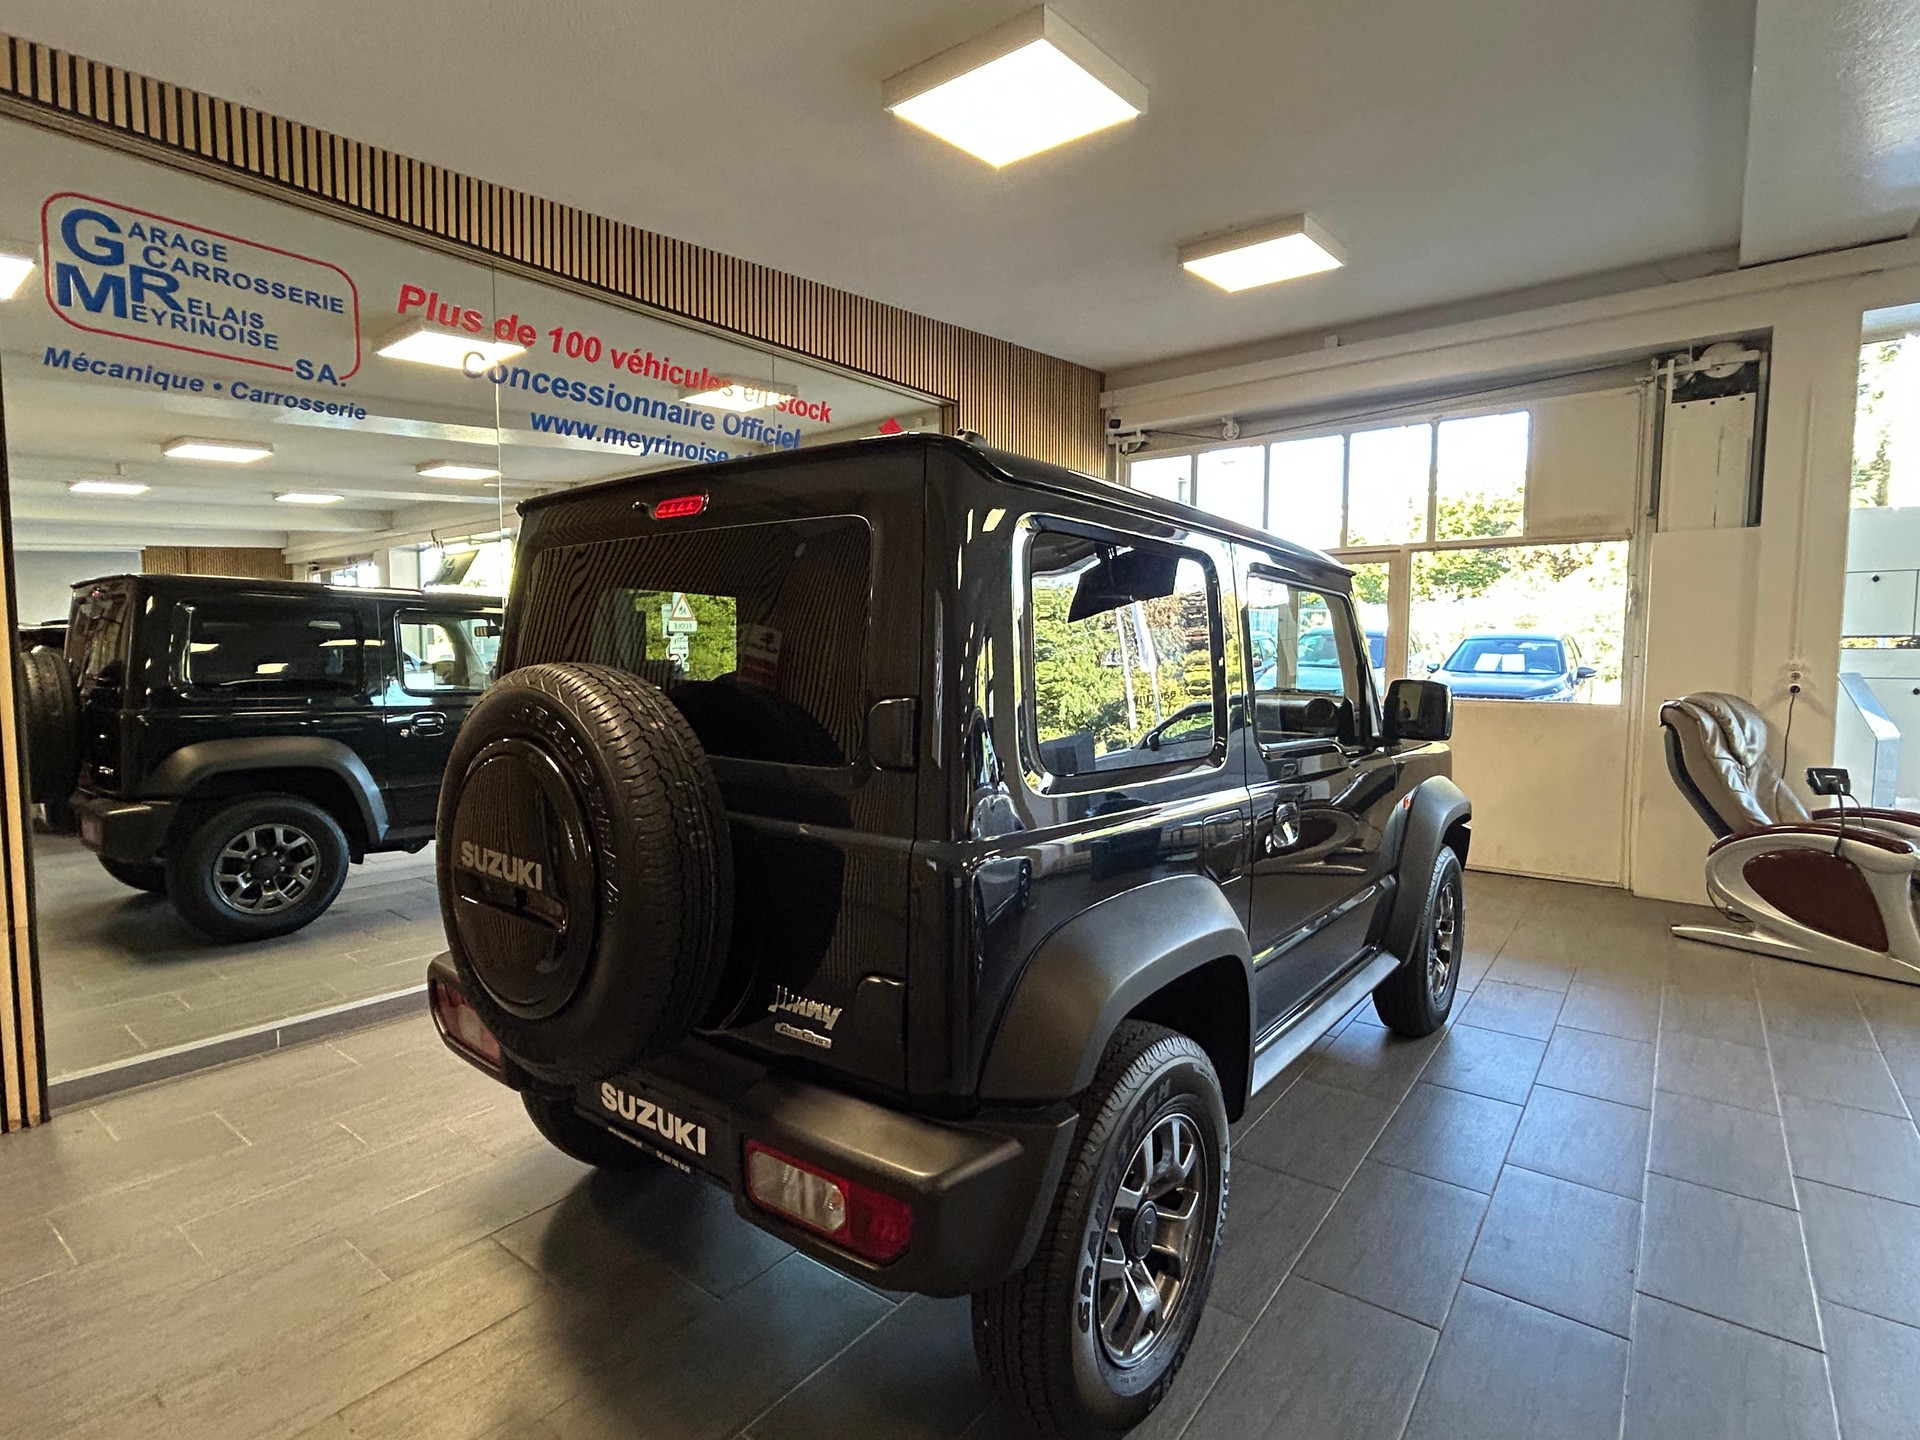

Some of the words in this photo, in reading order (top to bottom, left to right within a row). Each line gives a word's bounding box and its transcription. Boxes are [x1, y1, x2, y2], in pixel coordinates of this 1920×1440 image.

[142, 247, 344, 314] CARROSSERIE
[43, 346, 205, 393] Mécanique
[230, 381, 367, 420] Carrosserie
[397, 284, 482, 333] Plus
[494, 314, 537, 347] de
[548, 327, 603, 363] 100
[611, 347, 734, 397] véhicules
[775, 395, 832, 424] stock
[462, 351, 716, 431] Concessionnaire
[722, 412, 802, 449] Officiel
[461, 841, 543, 890] SUZUKI
[600, 1080, 707, 1156] SUZUKI
